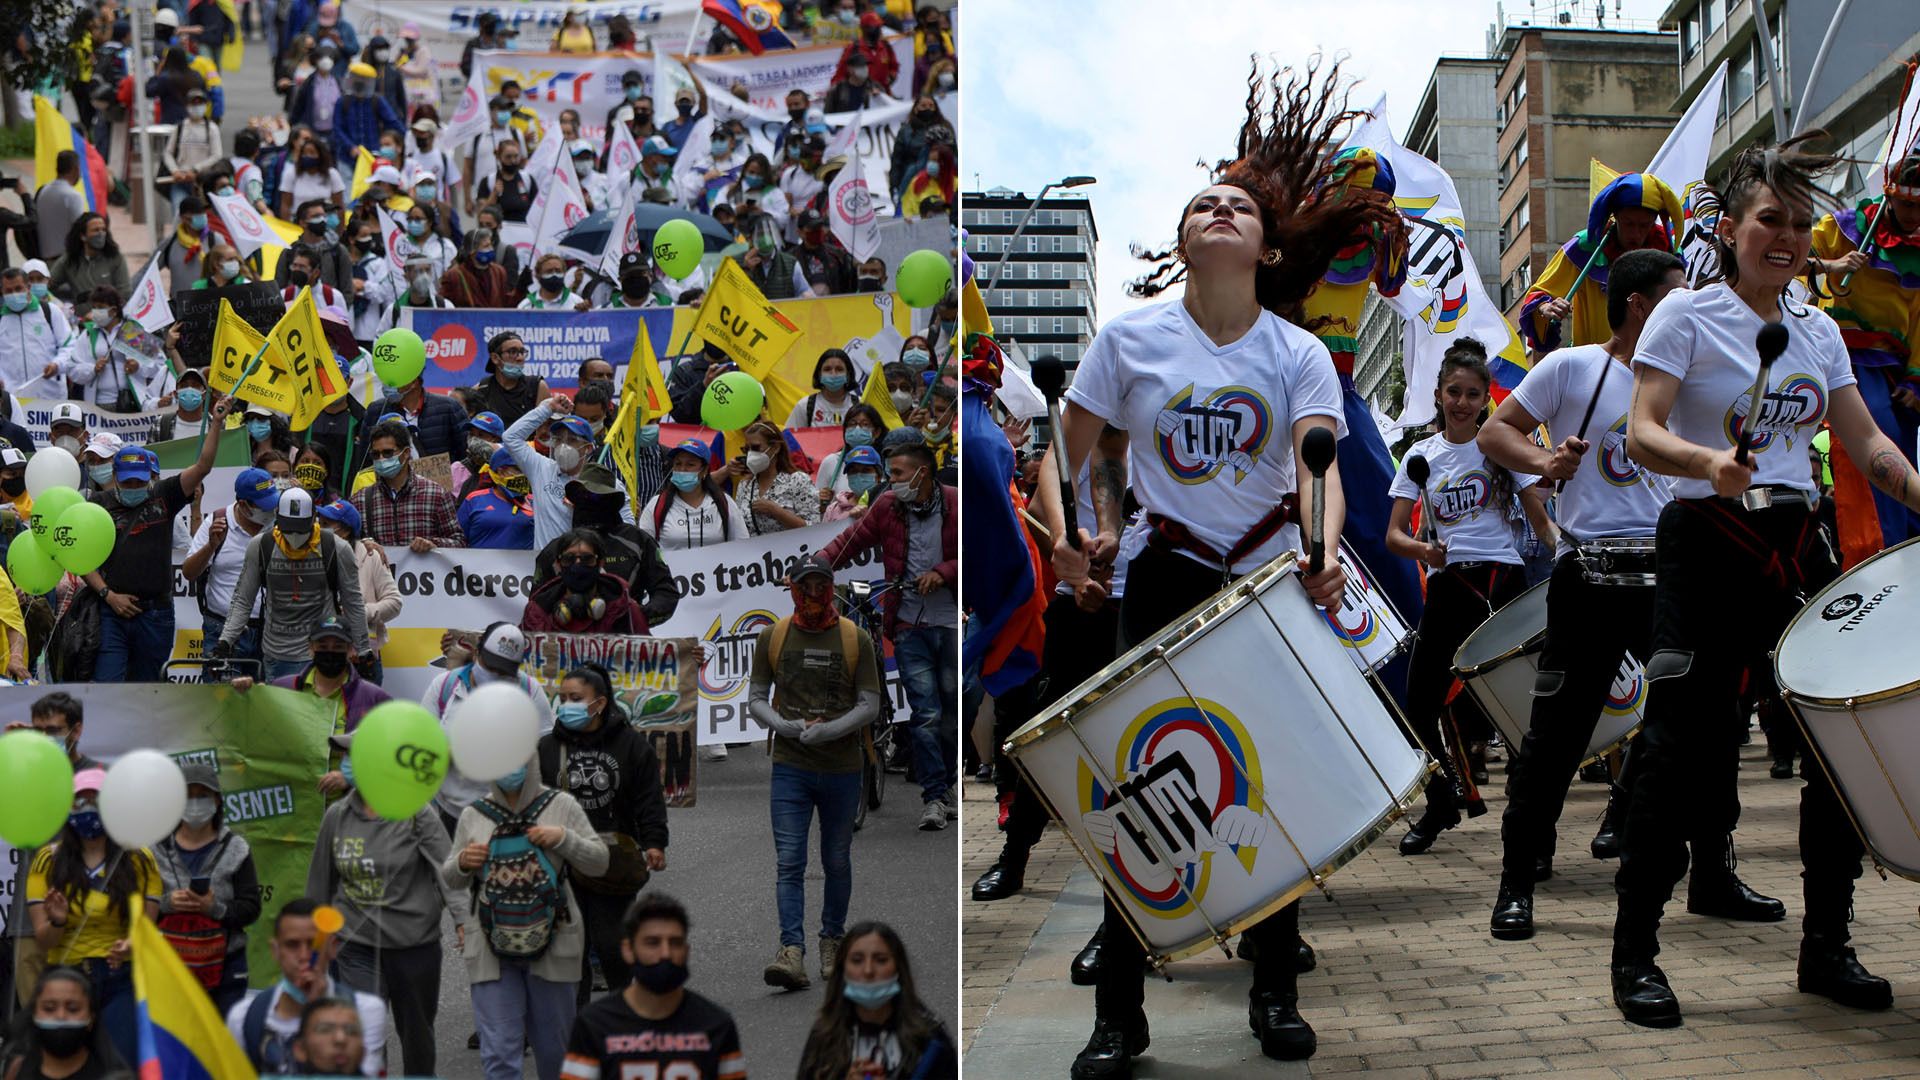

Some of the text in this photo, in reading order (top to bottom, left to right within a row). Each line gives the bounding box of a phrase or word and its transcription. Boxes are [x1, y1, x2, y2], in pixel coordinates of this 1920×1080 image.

[565, 326, 610, 342] APOYA
[720, 305, 768, 348] CUT
[224, 346, 287, 385] CUT
[287, 329, 313, 397] CUT
[425, 338, 466, 358] #5M
[535, 345, 602, 361] NACIONAL
[552, 362, 580, 378] 202
[1179, 410, 1238, 462] CUT
[1441, 488, 1475, 515] CUT
[444, 564, 534, 598] derec
[714, 638, 758, 681] CUT
[710, 700, 770, 735] PR
[224, 785, 293, 823] SENTE!
[1105, 768, 1216, 877] CUT
